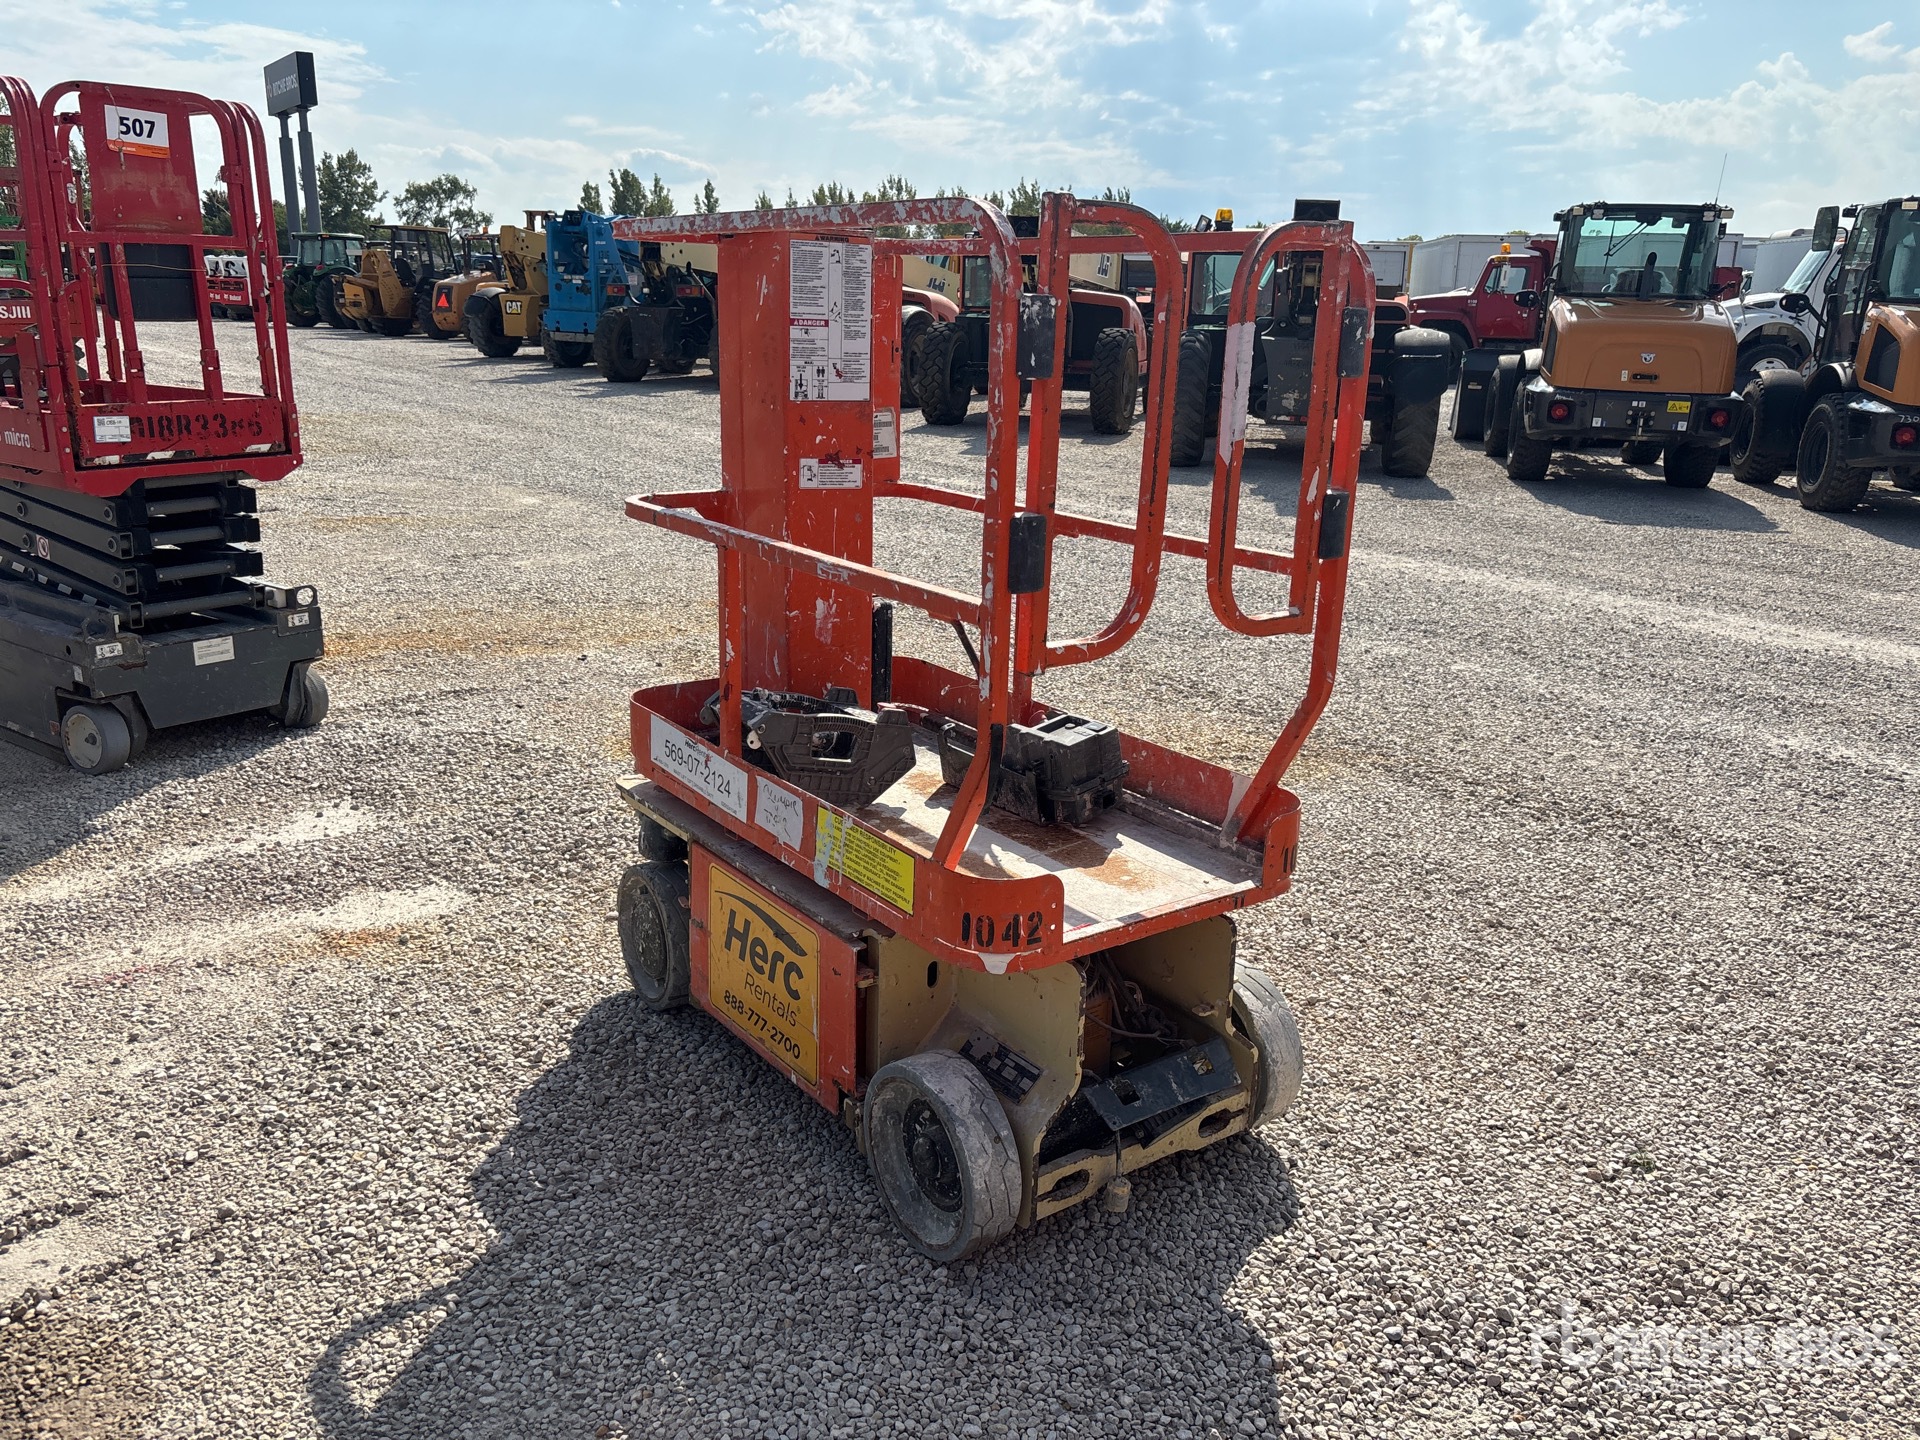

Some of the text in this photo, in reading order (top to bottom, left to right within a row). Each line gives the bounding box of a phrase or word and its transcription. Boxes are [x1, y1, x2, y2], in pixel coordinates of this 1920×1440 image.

[119, 115, 156, 139] 507
[820, 235, 850, 243] WARNING
[0, 305, 31, 319] SJIII
[506, 301, 522, 314] CAT
[1898, 414, 1920, 423] 730
[4, 428, 31, 449] micro
[664, 739, 732, 798] 569-07-2124
[834, 816, 858, 834] CUSMER
[961, 911, 1043, 948] 1042
[724, 908, 804, 1001] Herc
[744, 972, 797, 1027] Rentals
[723, 990, 801, 1060] 888-777-2700
